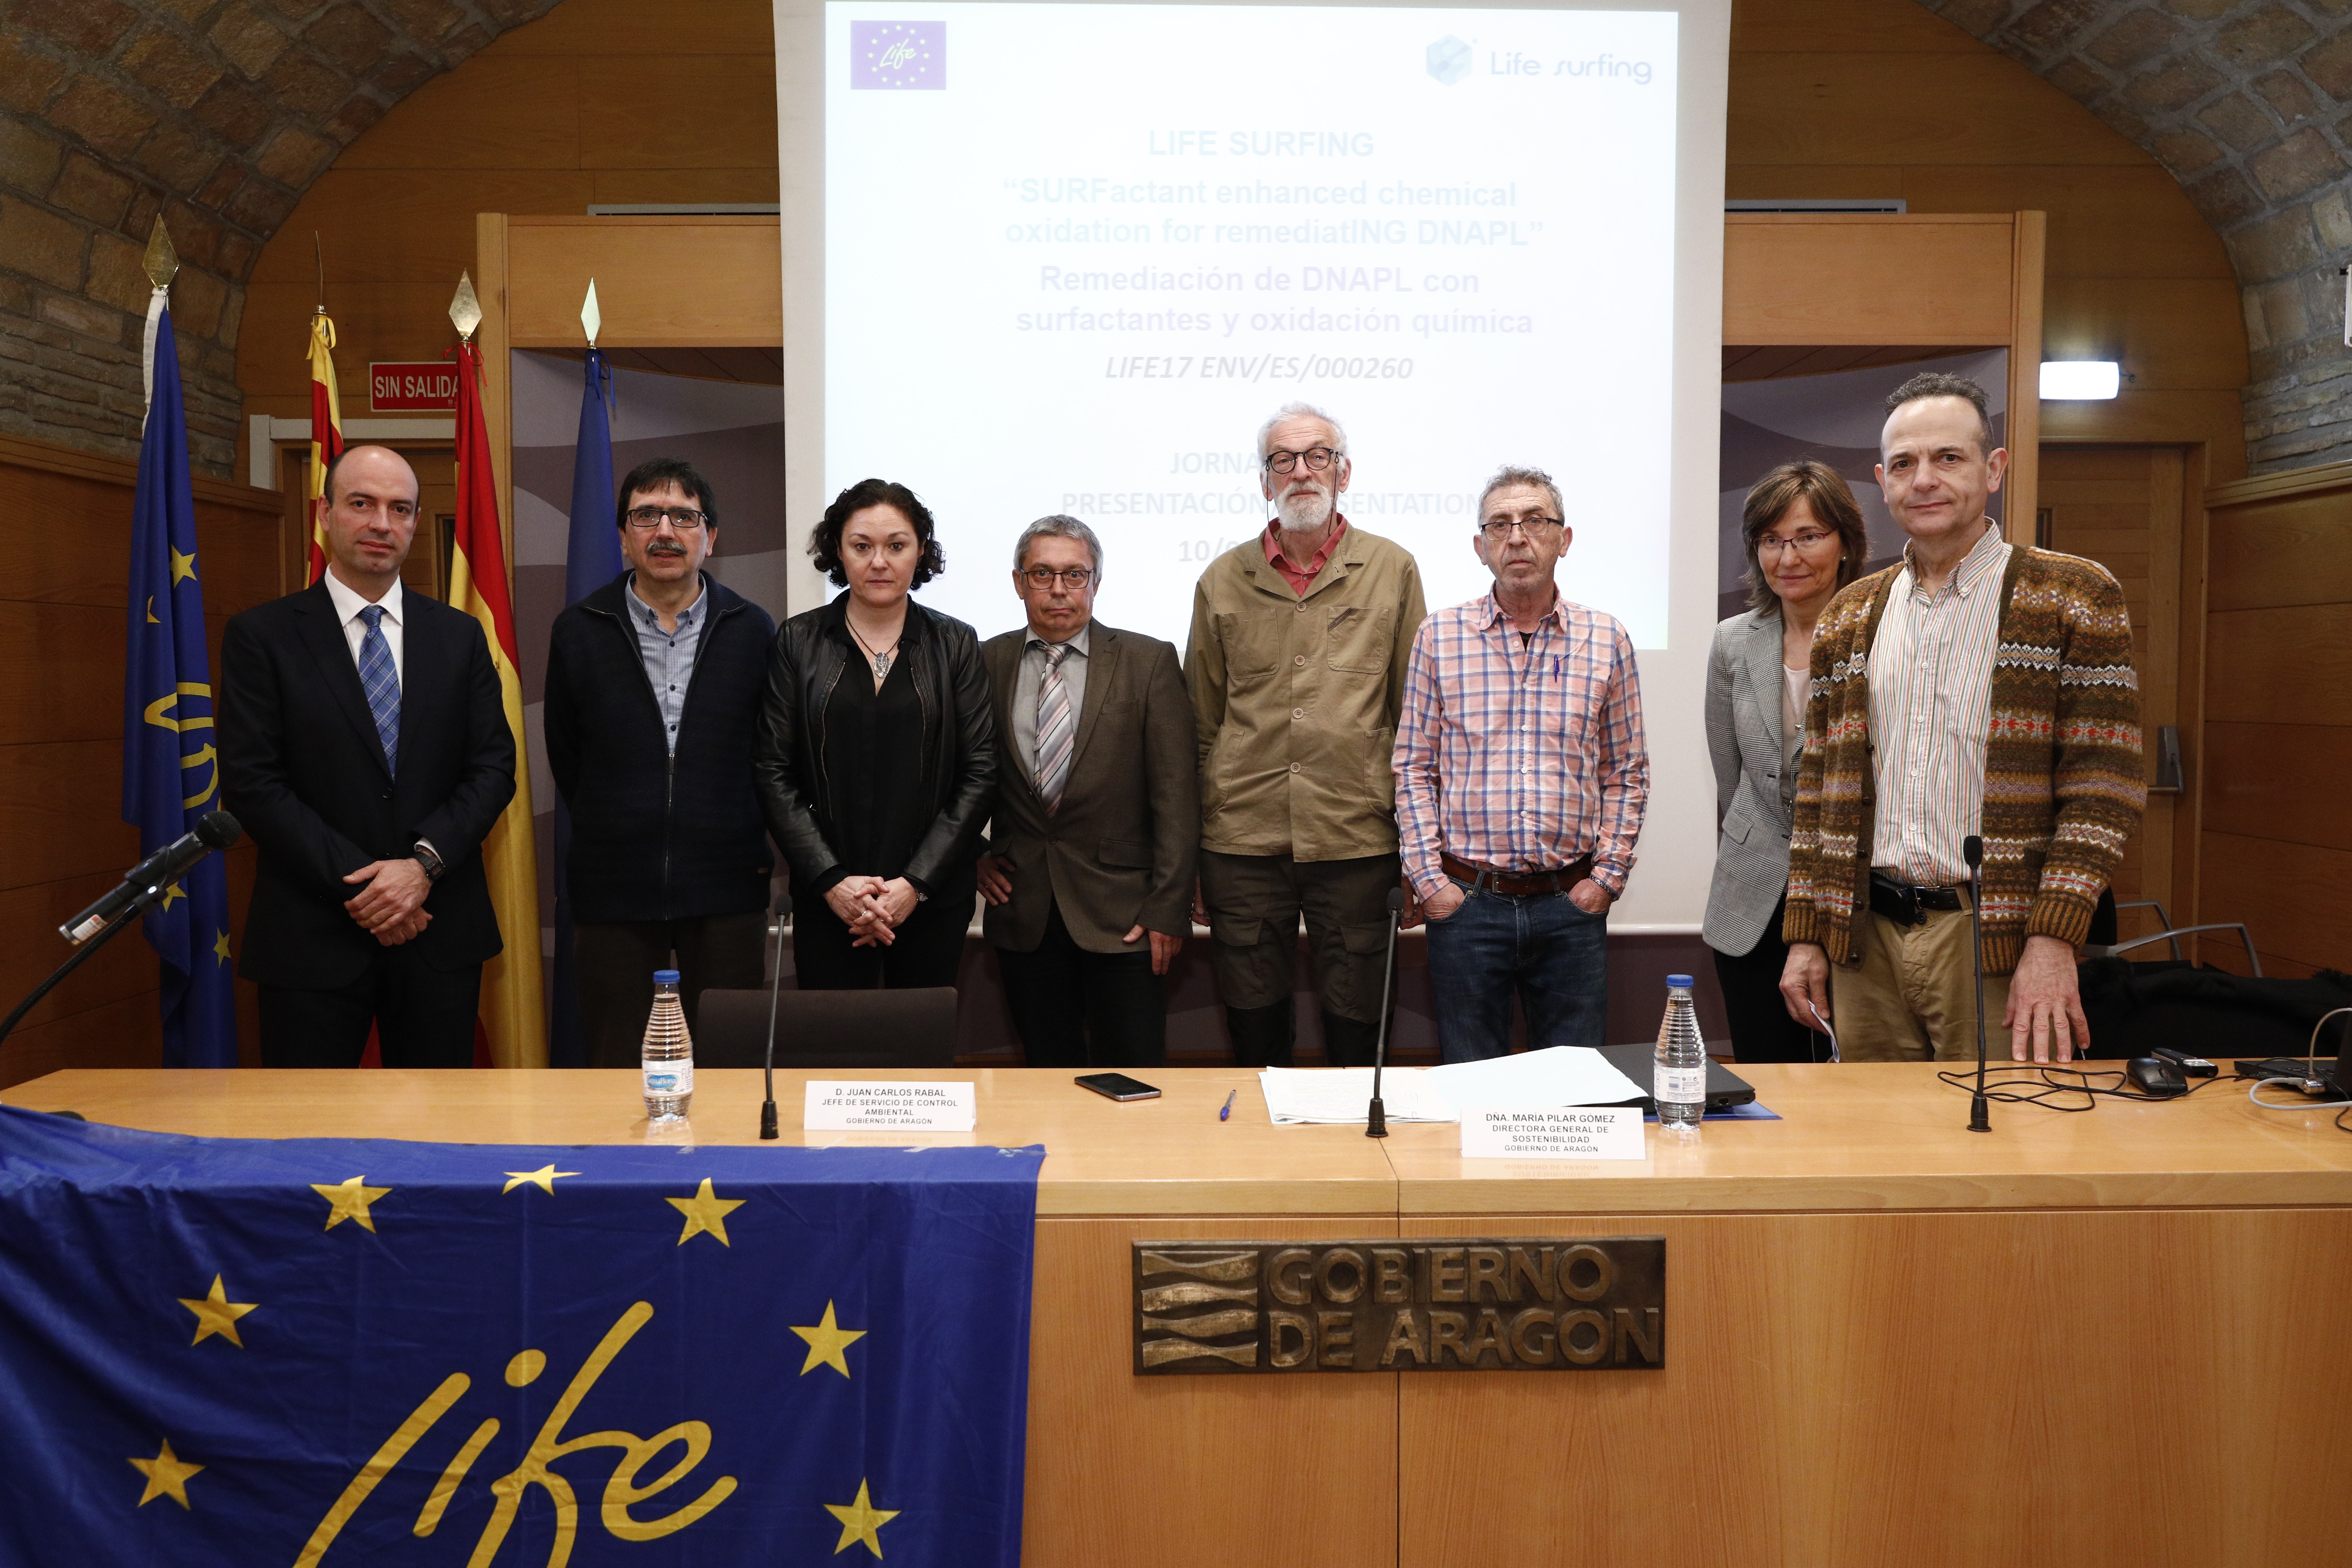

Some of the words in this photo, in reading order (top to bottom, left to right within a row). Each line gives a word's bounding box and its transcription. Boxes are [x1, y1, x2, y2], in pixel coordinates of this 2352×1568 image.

[879, 38, 917, 70] Life
[1491, 51, 1541, 76] Life
[1553, 53, 1652, 85] surfing
[1150, 131, 1217, 155] LIFE
[1229, 131, 1374, 156] SURFING
[1216, 180, 1367, 204] enhanced
[1378, 181, 1516, 206] chemical
[1006, 218, 1150, 243] oxidation
[1162, 218, 1206, 242] for
[1216, 219, 1406, 244] remediatING
[1041, 266, 1242, 291] Remediación
[1255, 267, 1290, 291] de
[1304, 267, 1413, 292] DNAPL
[1424, 275, 1479, 292] con
[1017, 306, 1211, 331] surfactantes
[1223, 313, 1239, 337] y
[1251, 307, 1400, 332] oxidación
[1413, 309, 1533, 338] química
[1105, 355, 1193, 378] LIFE17
[1200, 354, 1414, 383] ENV/ES/000260
[375, 376, 400, 398] SIN
[1170, 452, 1260, 474] JORNA
[1486, 1112, 1510, 1121] DÑA.
[1513, 1112, 1544, 1122] MARÍA
[1580, 1113, 1615, 1123] GÓMEZ
[1268, 1245, 1612, 1305] GOBIERNO
[1268, 1310, 1354, 1367] DE
[1380, 1308, 1659, 1366] ARAGON
